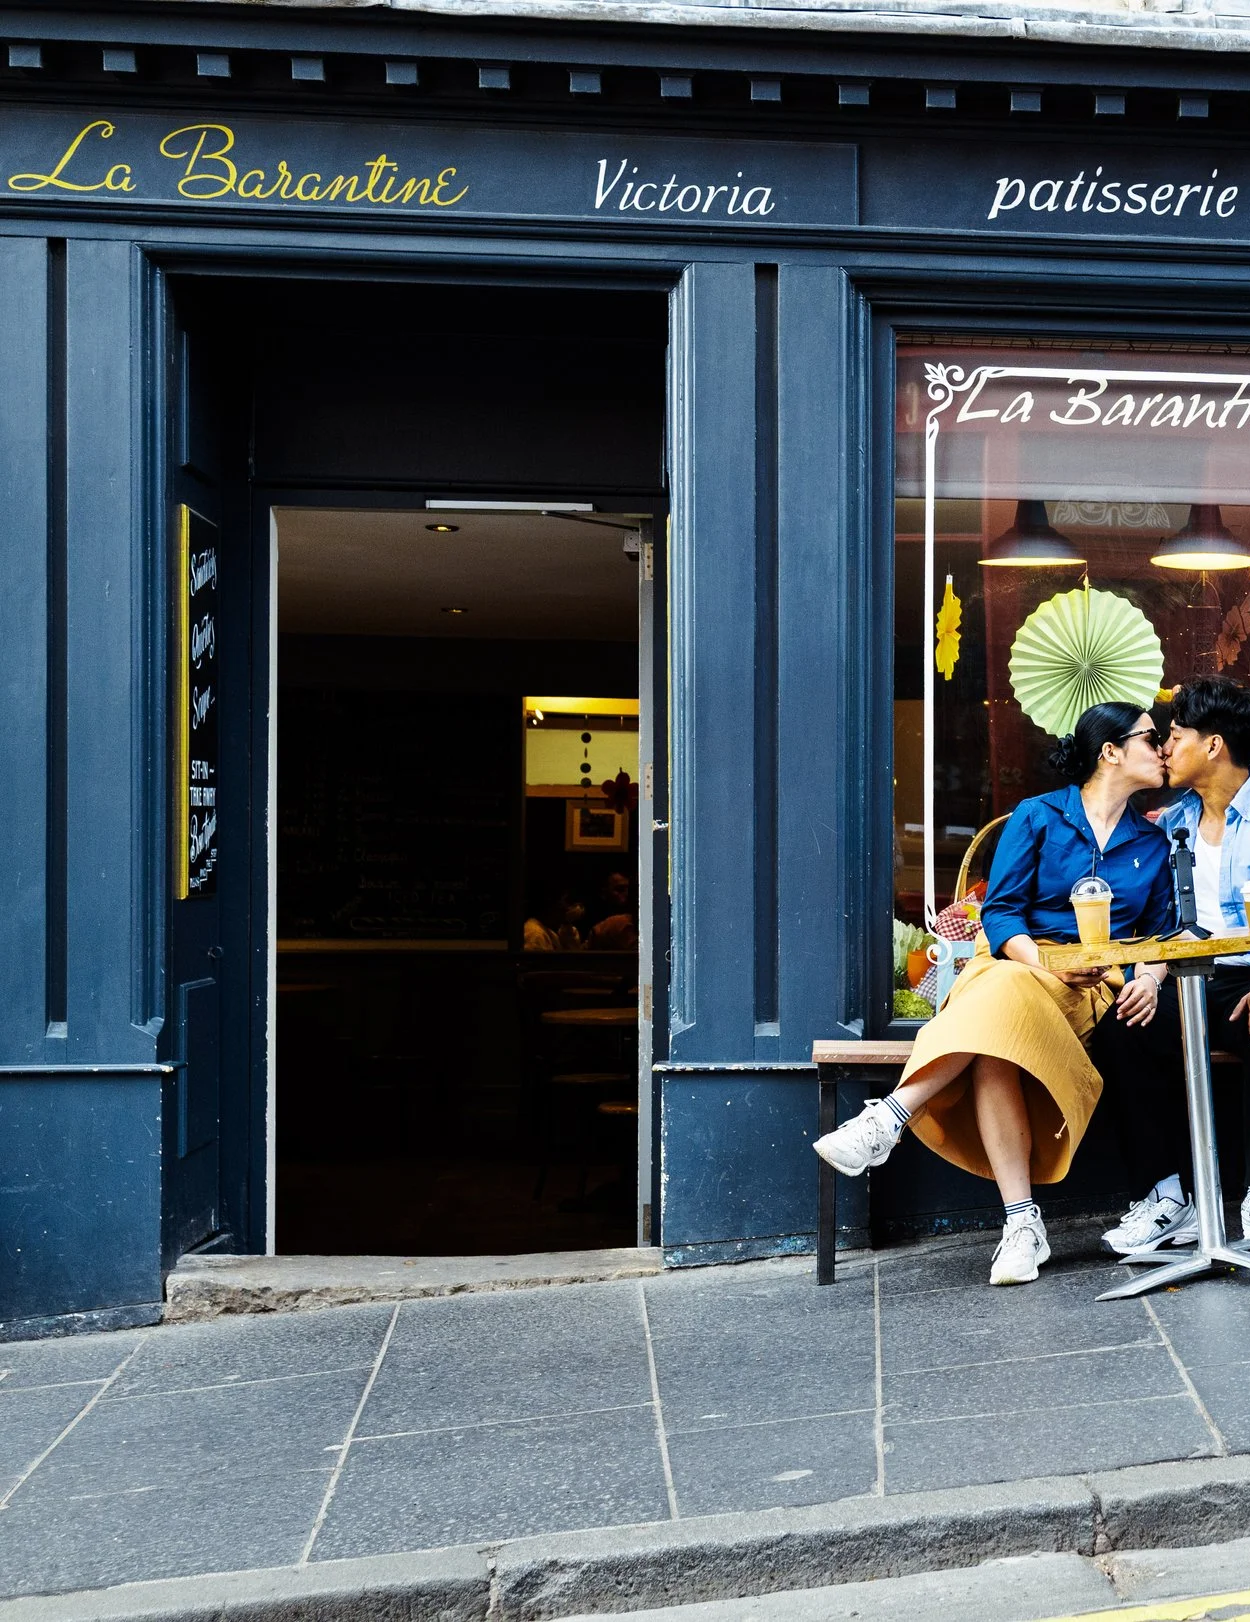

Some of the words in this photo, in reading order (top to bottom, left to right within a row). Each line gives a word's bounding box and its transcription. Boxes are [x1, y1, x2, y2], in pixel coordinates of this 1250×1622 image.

[9, 120, 136, 193] La
[160, 124, 469, 206] Barantine
[592, 158, 776, 216] Victoria
[988, 166, 1238, 219] patisserie
[956, 369, 1035, 424] La
[1153, 1213, 1172, 1230] N
